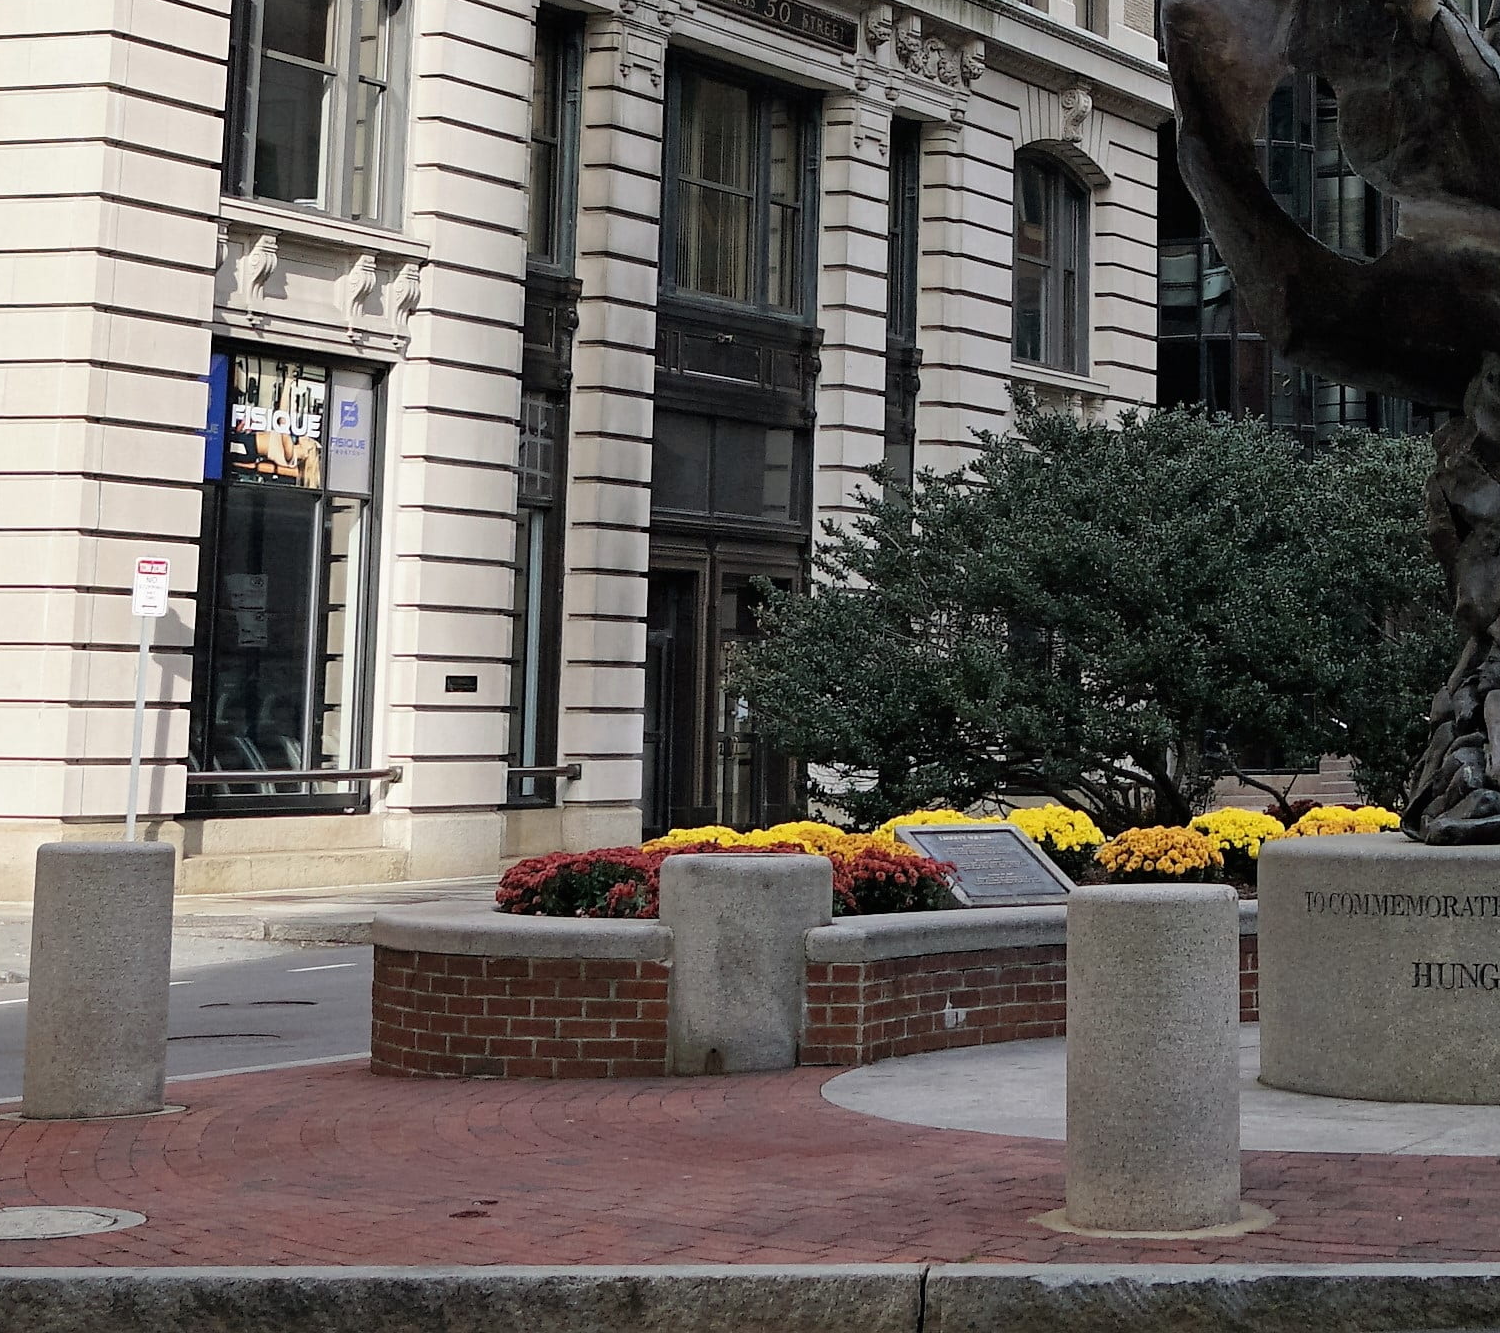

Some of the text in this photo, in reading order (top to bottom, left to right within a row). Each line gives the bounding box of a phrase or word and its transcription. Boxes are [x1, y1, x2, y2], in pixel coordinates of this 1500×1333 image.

[802, 13, 845, 41] STREET
[231, 403, 322, 438] FISIQUE
[1306, 891, 1325, 915] TO
